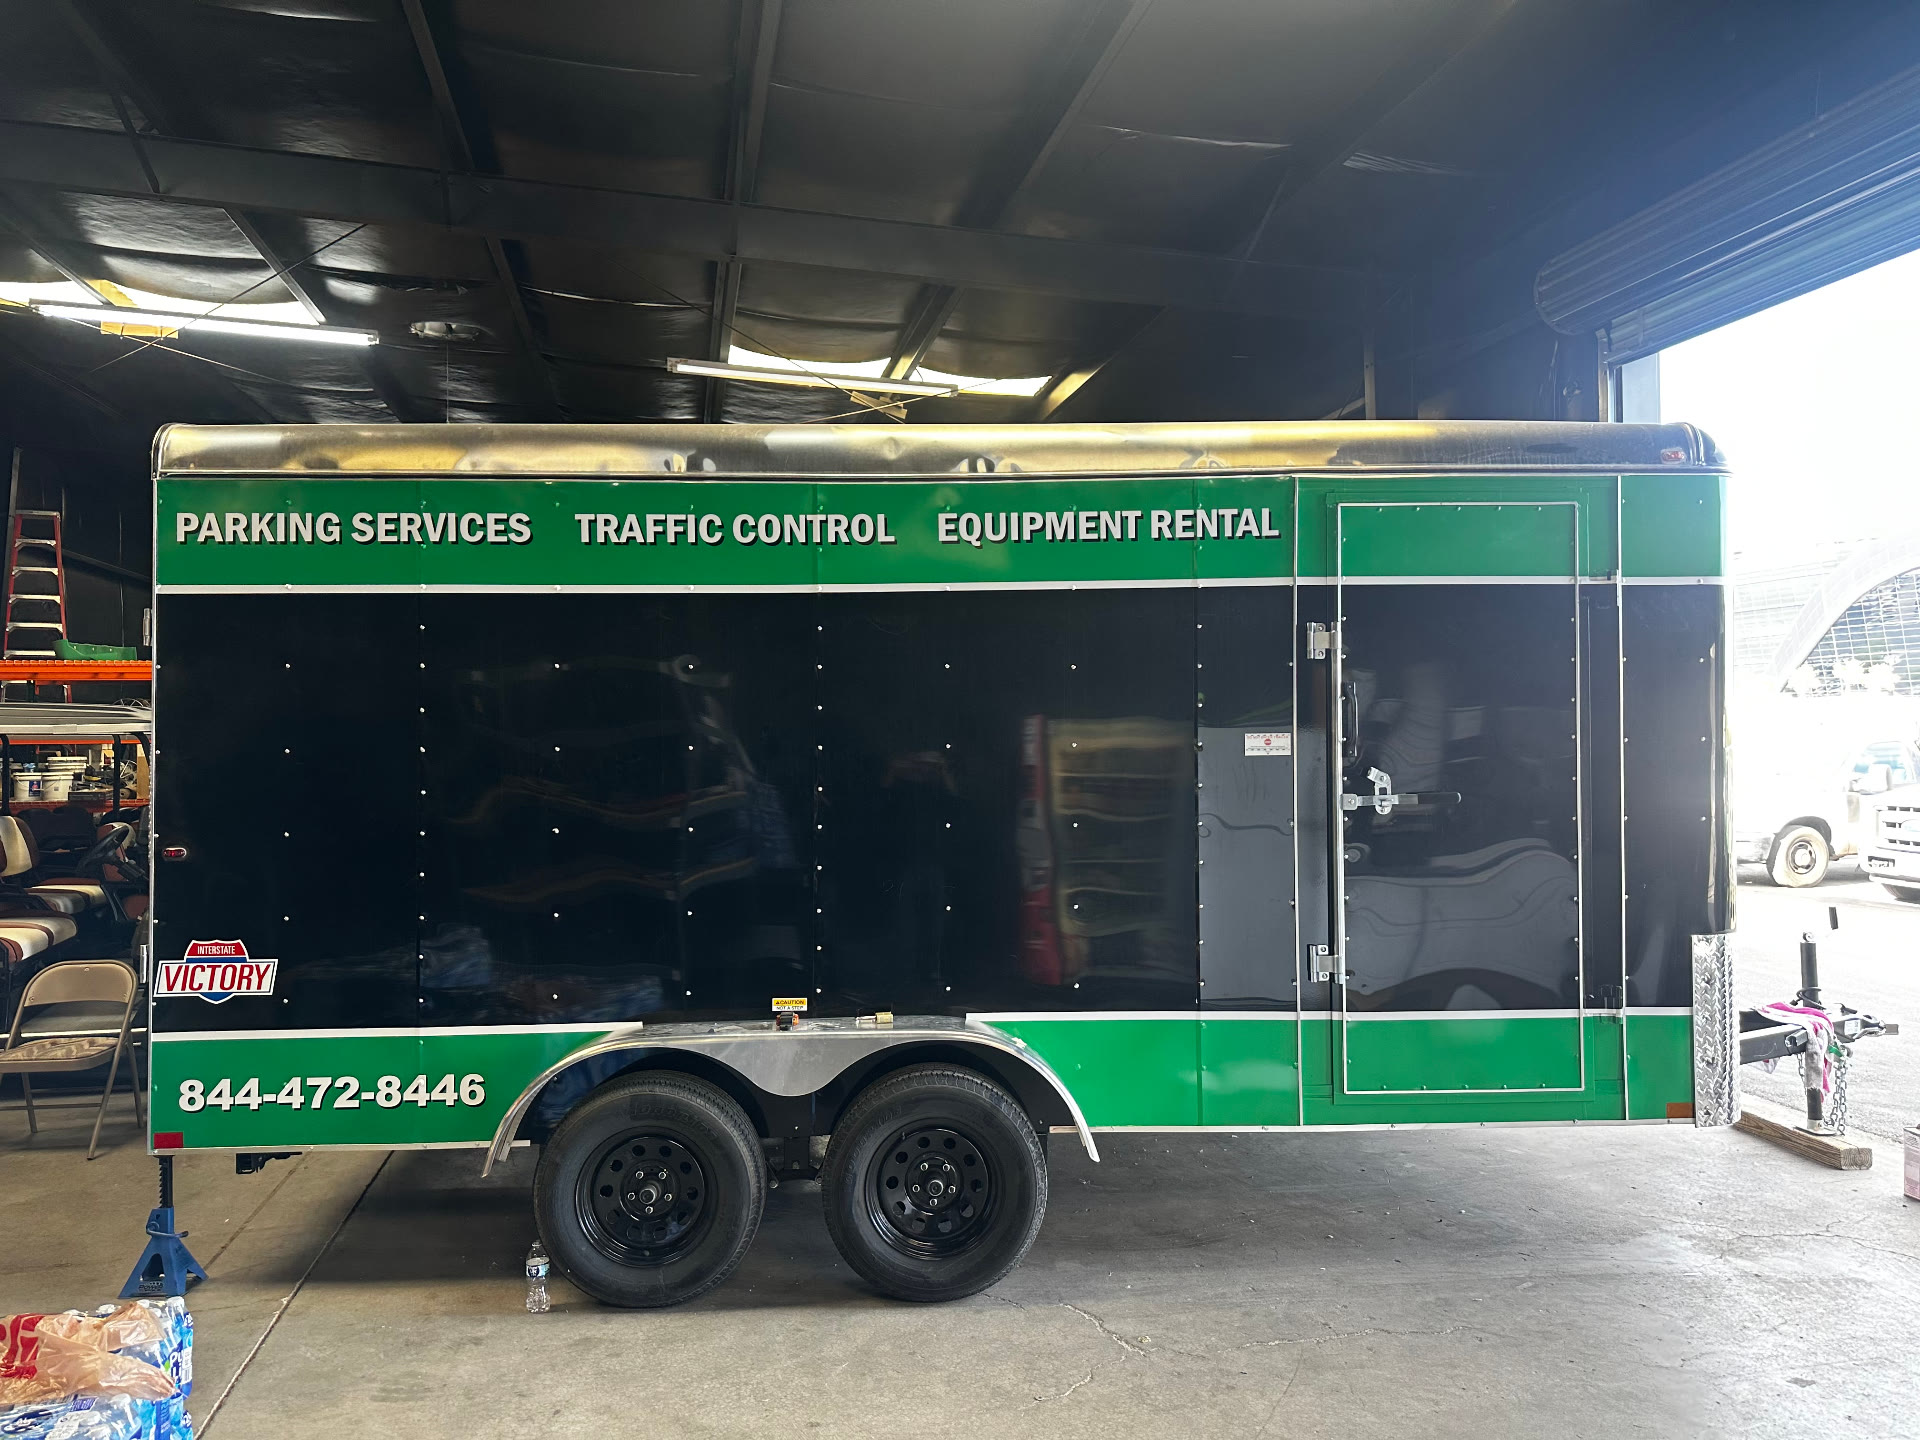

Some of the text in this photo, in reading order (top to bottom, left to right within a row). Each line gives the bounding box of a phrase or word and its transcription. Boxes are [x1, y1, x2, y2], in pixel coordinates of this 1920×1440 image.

[176, 512, 533, 545] PARKING SERVICES
[574, 513, 898, 546] TRAFFIC CONTROL
[937, 504, 1281, 549] EQUIPMENT RENTAL
[197, 945, 236, 955] INTERSTATE
[164, 964, 272, 992] VICTORY
[178, 1073, 488, 1112] 844-472-8446
